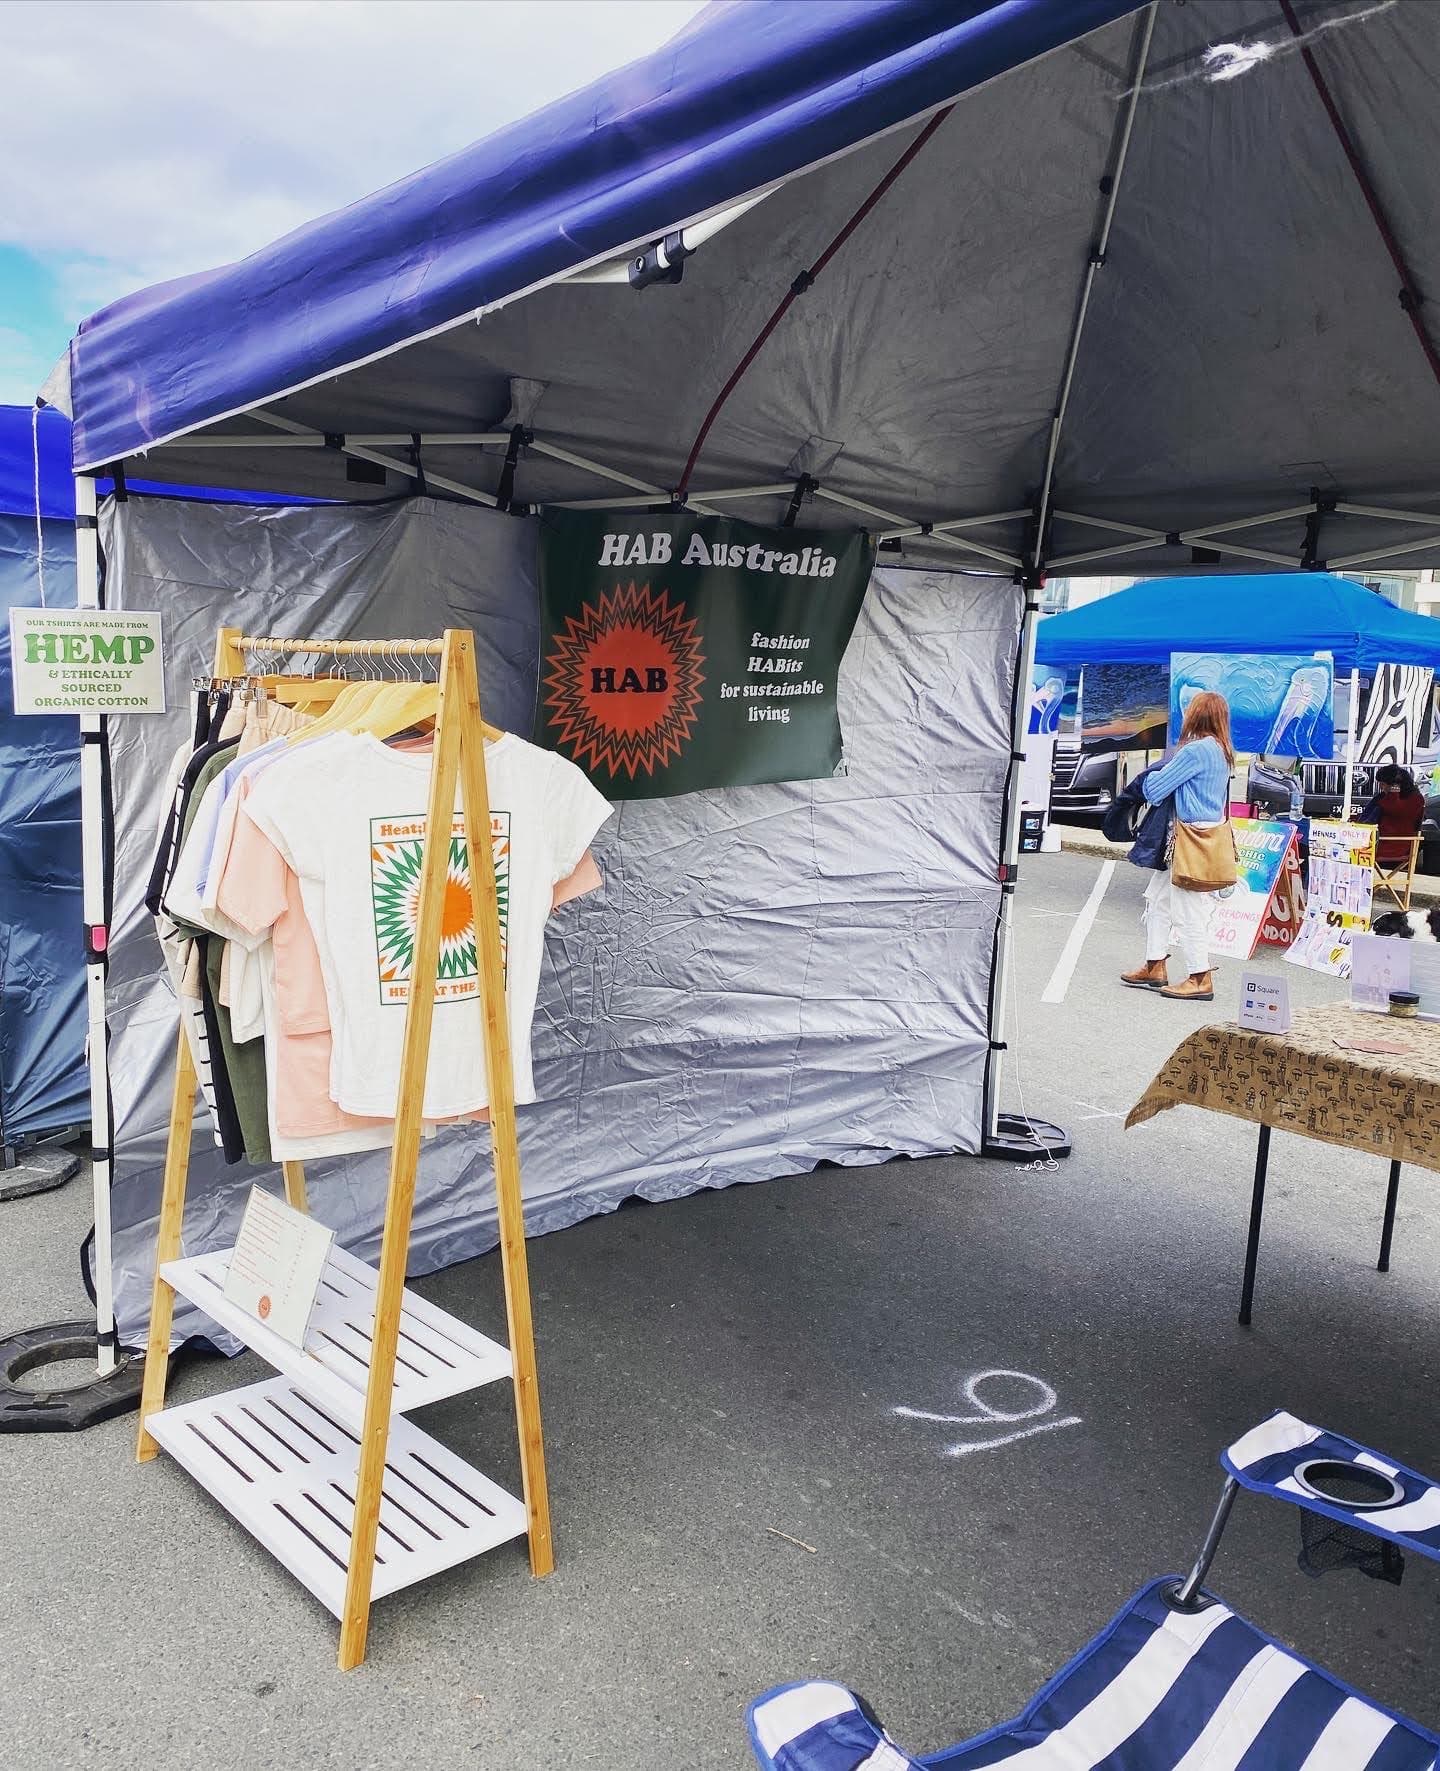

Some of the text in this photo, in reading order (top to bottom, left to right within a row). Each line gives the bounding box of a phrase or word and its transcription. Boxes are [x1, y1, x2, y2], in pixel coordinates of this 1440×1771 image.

[598, 532, 837, 578] HAB Australia
[46, 620, 81, 628] TSHIRTS
[24, 633, 155, 664] HEMP
[750, 632, 810, 650] fashion
[747, 656, 804, 673] HABits
[48, 670, 133, 679] & ETHICALLY
[590, 667, 669, 694] HAB
[61, 683, 122, 693] SOURCED
[720, 679, 824, 698] for sustainable
[34, 697, 148, 706] ORGANIC COTTON
[748, 705, 790, 723] living
[450, 982, 476, 995] THE
[1257, 984, 1280, 995] Square
